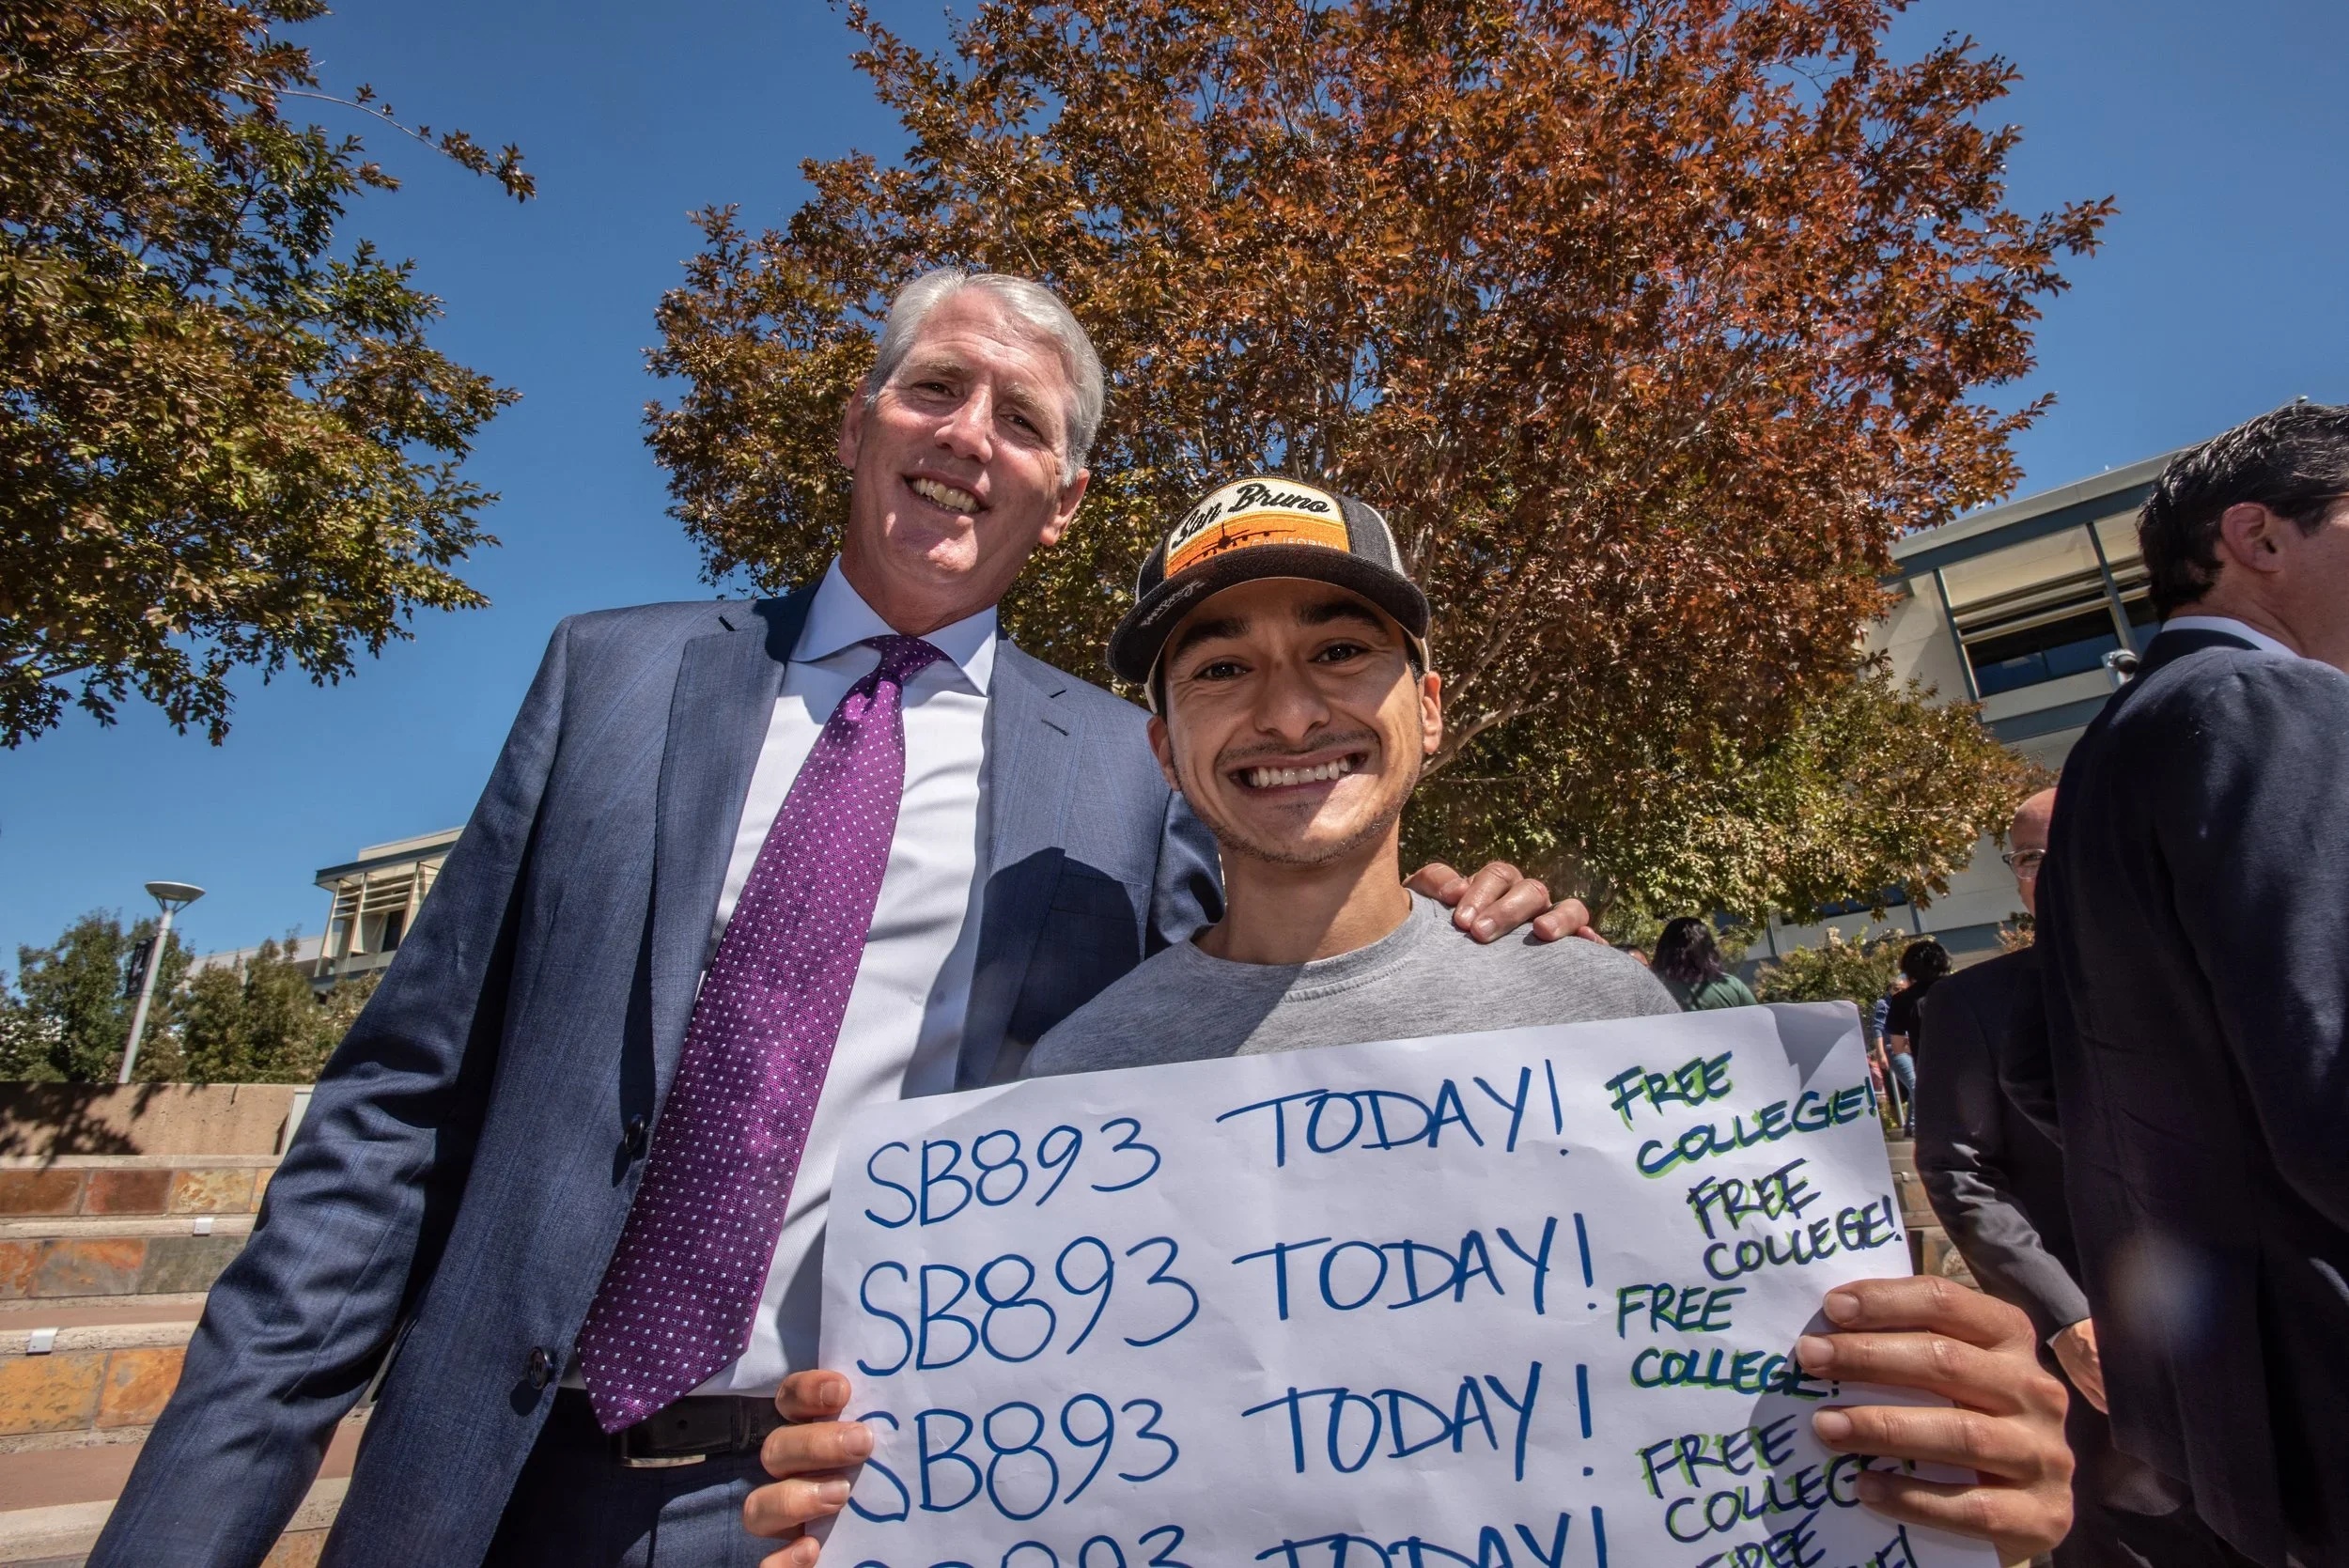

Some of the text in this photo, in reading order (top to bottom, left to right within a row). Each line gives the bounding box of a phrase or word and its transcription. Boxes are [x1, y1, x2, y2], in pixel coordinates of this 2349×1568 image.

[1172, 482, 1330, 549] San Bruno
[1604, 1051, 1734, 1131] FREE
[1636, 1076, 1877, 1178] COLLEGE!
[865, 1059, 1569, 1228] SB893 TODAY!
[1686, 1158, 1821, 1239] FREE
[1703, 1195, 1903, 1281] COLLEGE!
[857, 1212, 1597, 1376] SB893 TODAY!
[1616, 1283, 1747, 1339] FREE
[848, 1360, 1595, 1523] SB893 TODAY!
[1635, 1414, 1798, 1500] FREE
